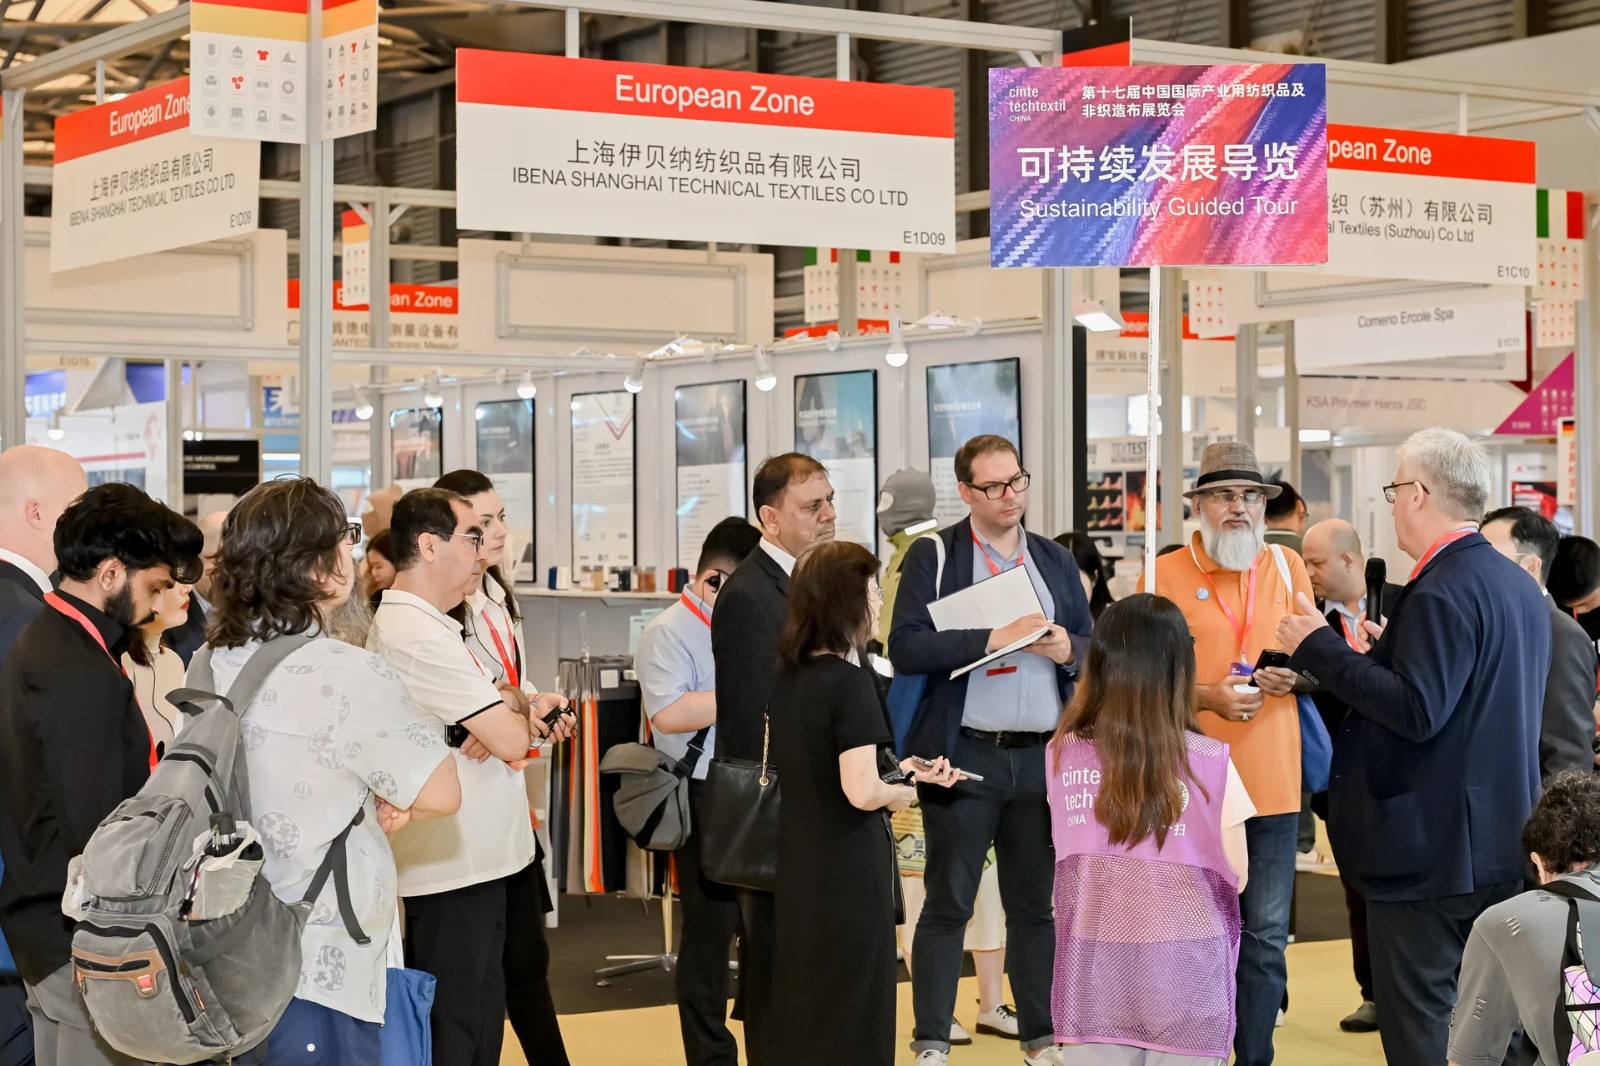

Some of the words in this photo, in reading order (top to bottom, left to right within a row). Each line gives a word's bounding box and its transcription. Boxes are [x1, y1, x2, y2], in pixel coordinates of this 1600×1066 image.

[615, 74, 741, 111] European
[750, 85, 815, 115] Zone
[1009, 86, 1039, 98] cinte
[1081, 82, 1306, 101] 第十七届中国国际产业用纺织品及
[1009, 99, 1066, 113] techtextil
[1082, 102, 1186, 118] 非织造布展览会
[109, 103, 162, 137] European
[567, 139, 860, 182] 上海伊贝纳纺织品有限公司
[1328, 139, 1377, 163] pean
[1382, 138, 1432, 165] Zone
[90, 148, 213, 201] 上海伊贝纳纺织品有限公司
[1017, 143, 1300, 184] 可持续发展导览
[90, 200, 126, 222] SHANGHAI
[128, 188, 168, 213] TECHNICAL
[169, 180, 206, 203] TEXTILES
[206, 176, 219, 194] CO
[220, 173, 235, 192] LTD
[513, 167, 566, 186] IBENA
[571, 171, 662, 191] SHANGHAI
[668, 177, 764, 198] TECHNICAL
[768, 183, 846, 202] TEXTILES
[850, 188, 875, 204] CO
[880, 190, 908, 206] LTD
[229, 210, 252, 228] E1D09
[1020, 198, 1161, 220] Sustainability
[1168, 196, 1245, 217] Guided
[1254, 196, 1298, 215] Tour
[903, 230, 946, 246] E1D09
[1338, 220, 1381, 236] Textiles
[1384, 223, 1435, 241] (Suzhou)
[1437, 226, 1454, 241] Co
[1456, 227, 1474, 243] Ltd
[1497, 265, 1530, 279] E1C10
[414, 292, 453, 308] Zone
[1433, 308, 1454, 323] Spa
[1062, 765, 1101, 787] cinte
[1064, 788, 1096, 811] tech
